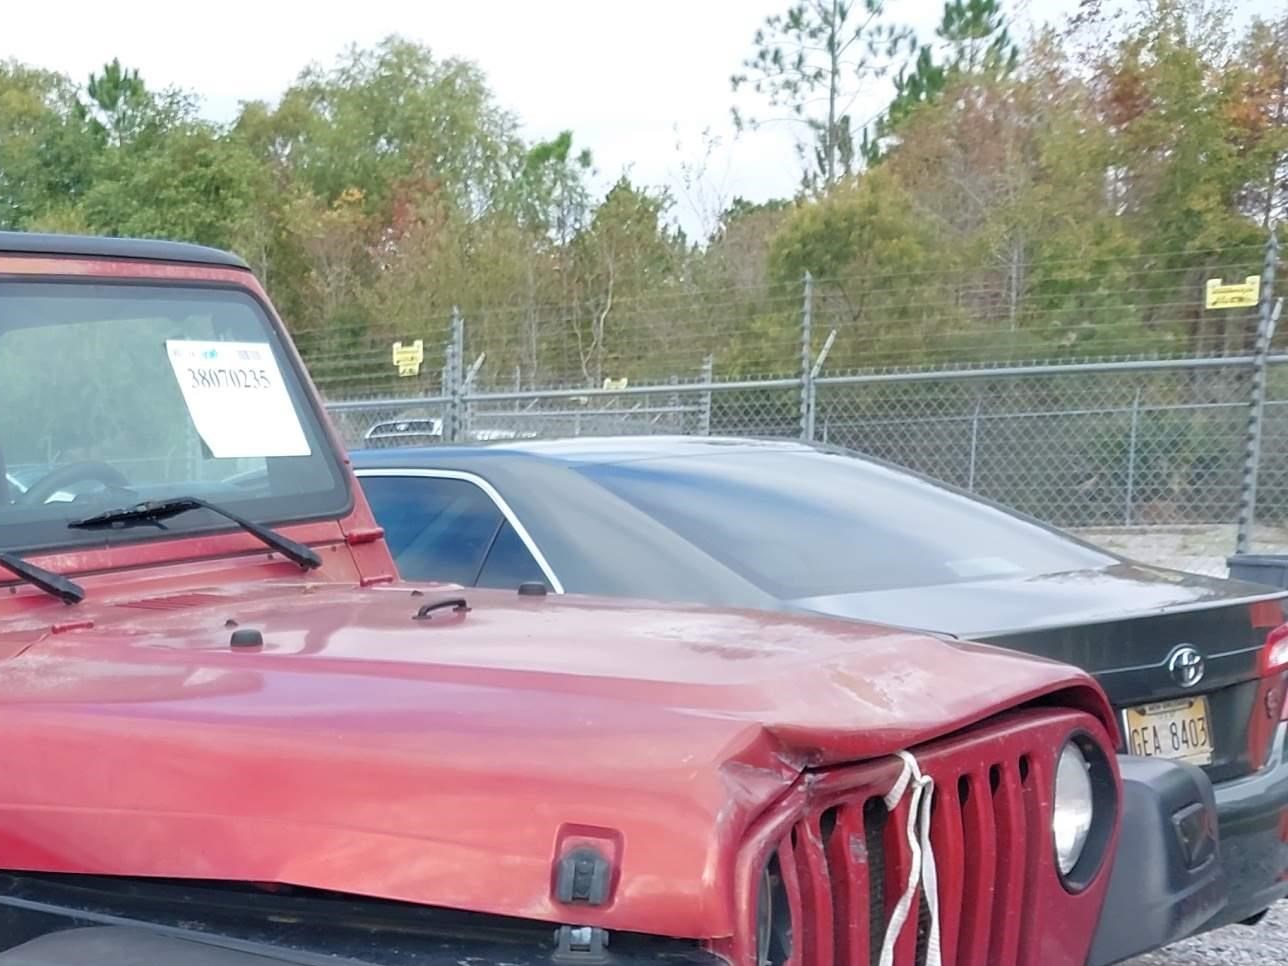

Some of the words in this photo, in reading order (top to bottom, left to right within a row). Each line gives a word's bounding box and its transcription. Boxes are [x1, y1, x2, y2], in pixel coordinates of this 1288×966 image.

[186, 367, 272, 390] 38070235
[1132, 725, 1161, 756] GEA
[1170, 717, 1207, 751] 8403
